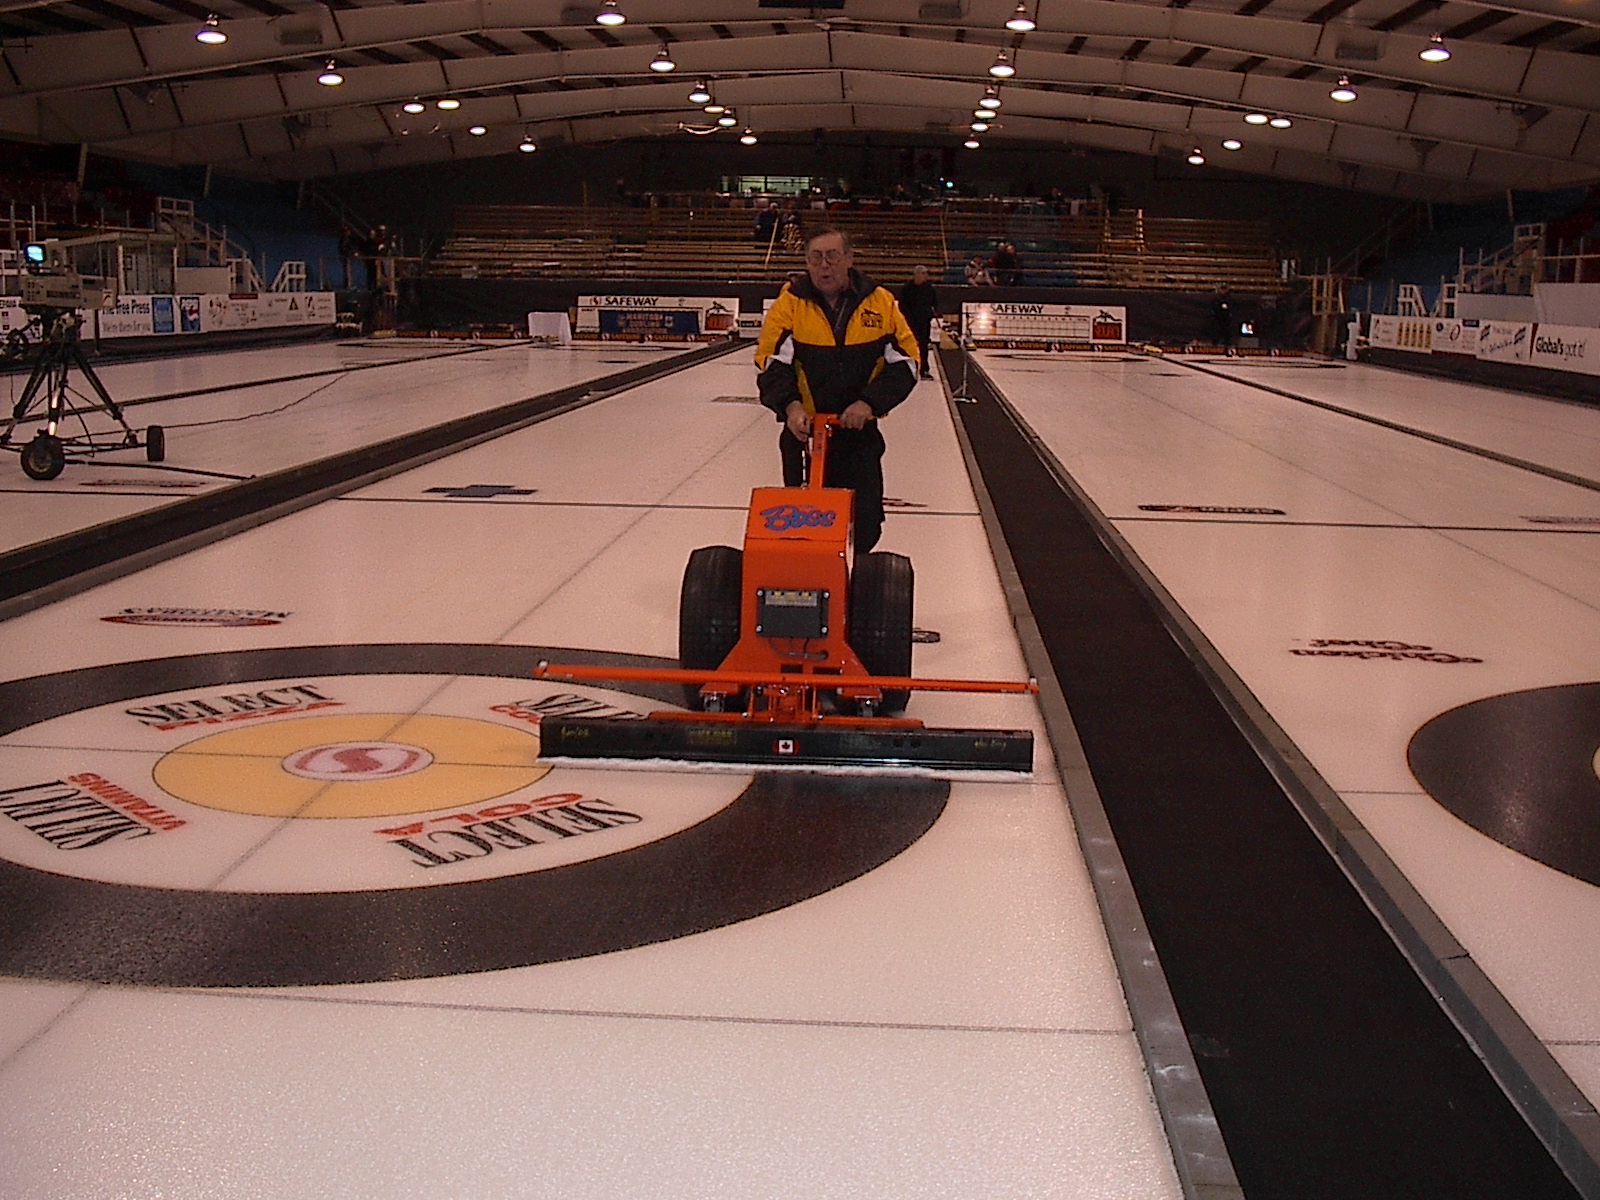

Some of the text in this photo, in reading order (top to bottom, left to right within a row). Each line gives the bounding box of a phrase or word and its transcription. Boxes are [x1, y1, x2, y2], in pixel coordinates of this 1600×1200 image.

[131, 299, 150, 314] Press
[605, 297, 659, 306] SAFEWAY
[991, 304, 1044, 313] SAFEWAY
[1535, 336, 1564, 355] Global's
[760, 504, 836, 532] Boss
[125, 684, 333, 726] SELECT
[68, 772, 187, 832] VITAMINS
[373, 792, 583, 837] COLA
[387, 798, 643, 869] SELECT
